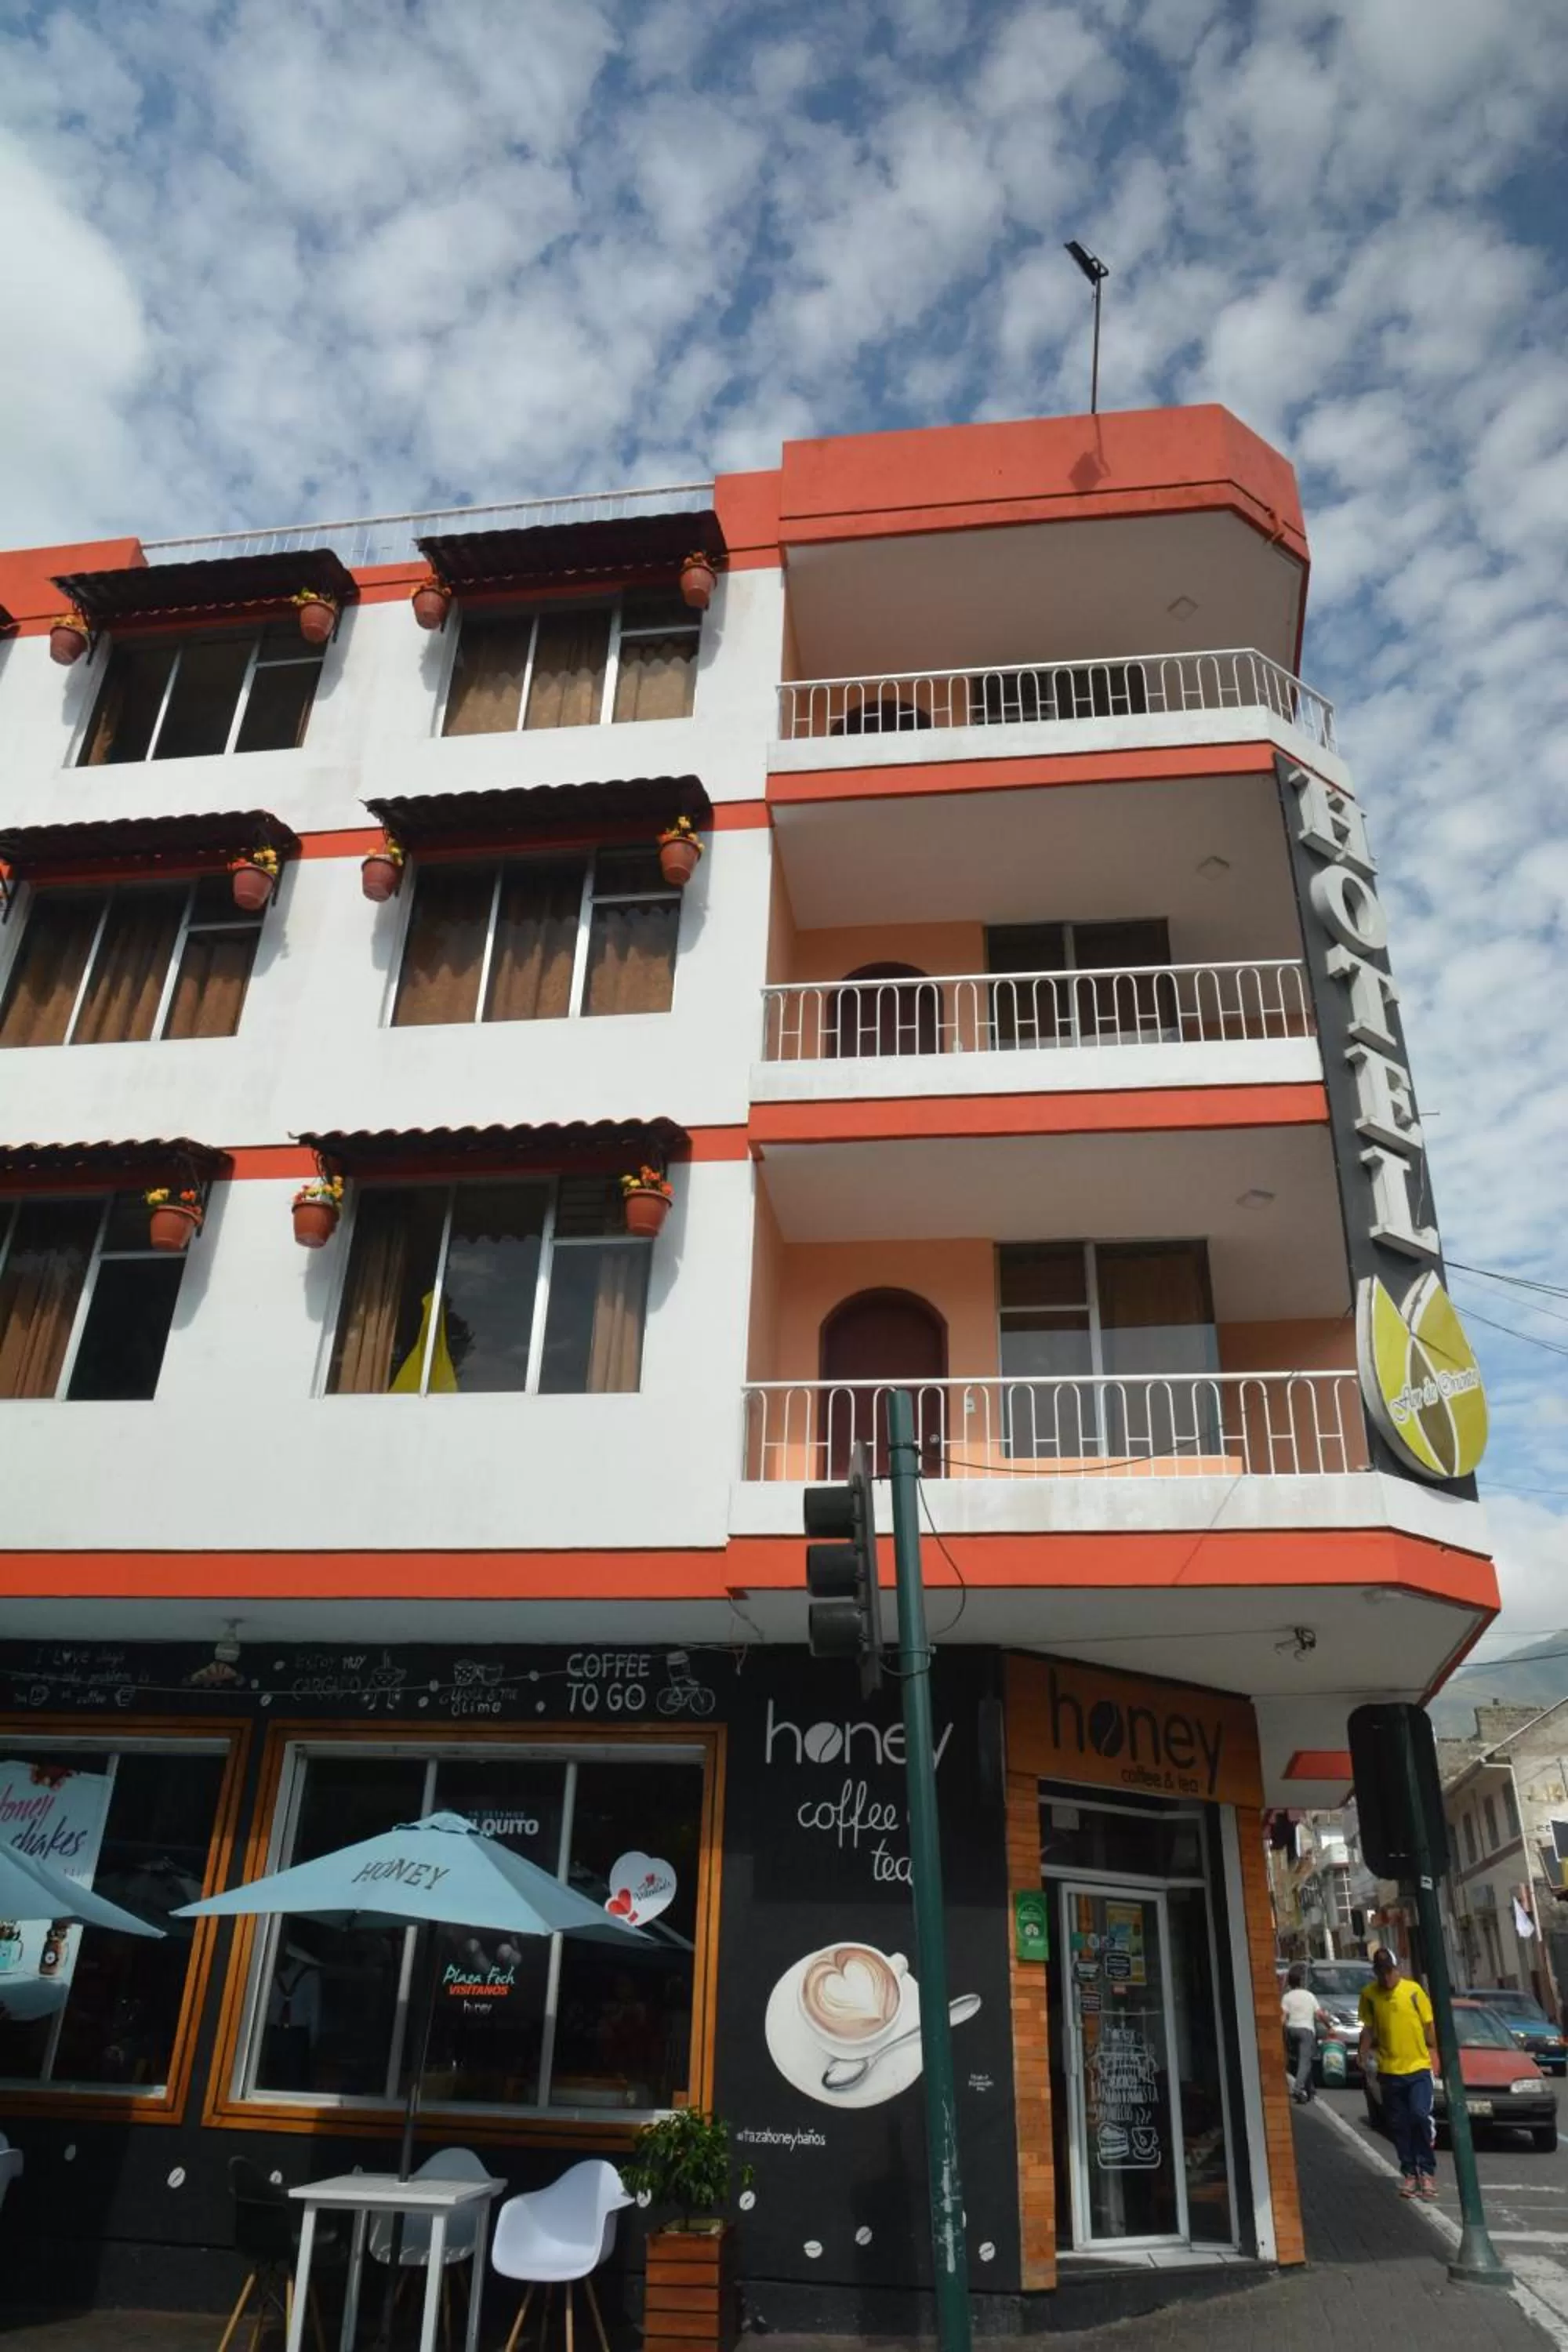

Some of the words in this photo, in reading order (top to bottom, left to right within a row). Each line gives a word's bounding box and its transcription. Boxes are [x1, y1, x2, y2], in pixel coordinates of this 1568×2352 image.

[1287, 768, 1441, 1255] HOTEL
[567, 1653, 651, 1679] COFFEE
[567, 1682, 599, 1712] TO
[608, 1682, 646, 1711] GO
[1050, 1668, 1223, 1795] honey
[481, 1818, 539, 1836] QUITO
[797, 1778, 899, 1849] coffee
[351, 1857, 450, 1891] HONEY
[871, 1838, 913, 1886] tea
[443, 1963, 481, 1984] Plaza
